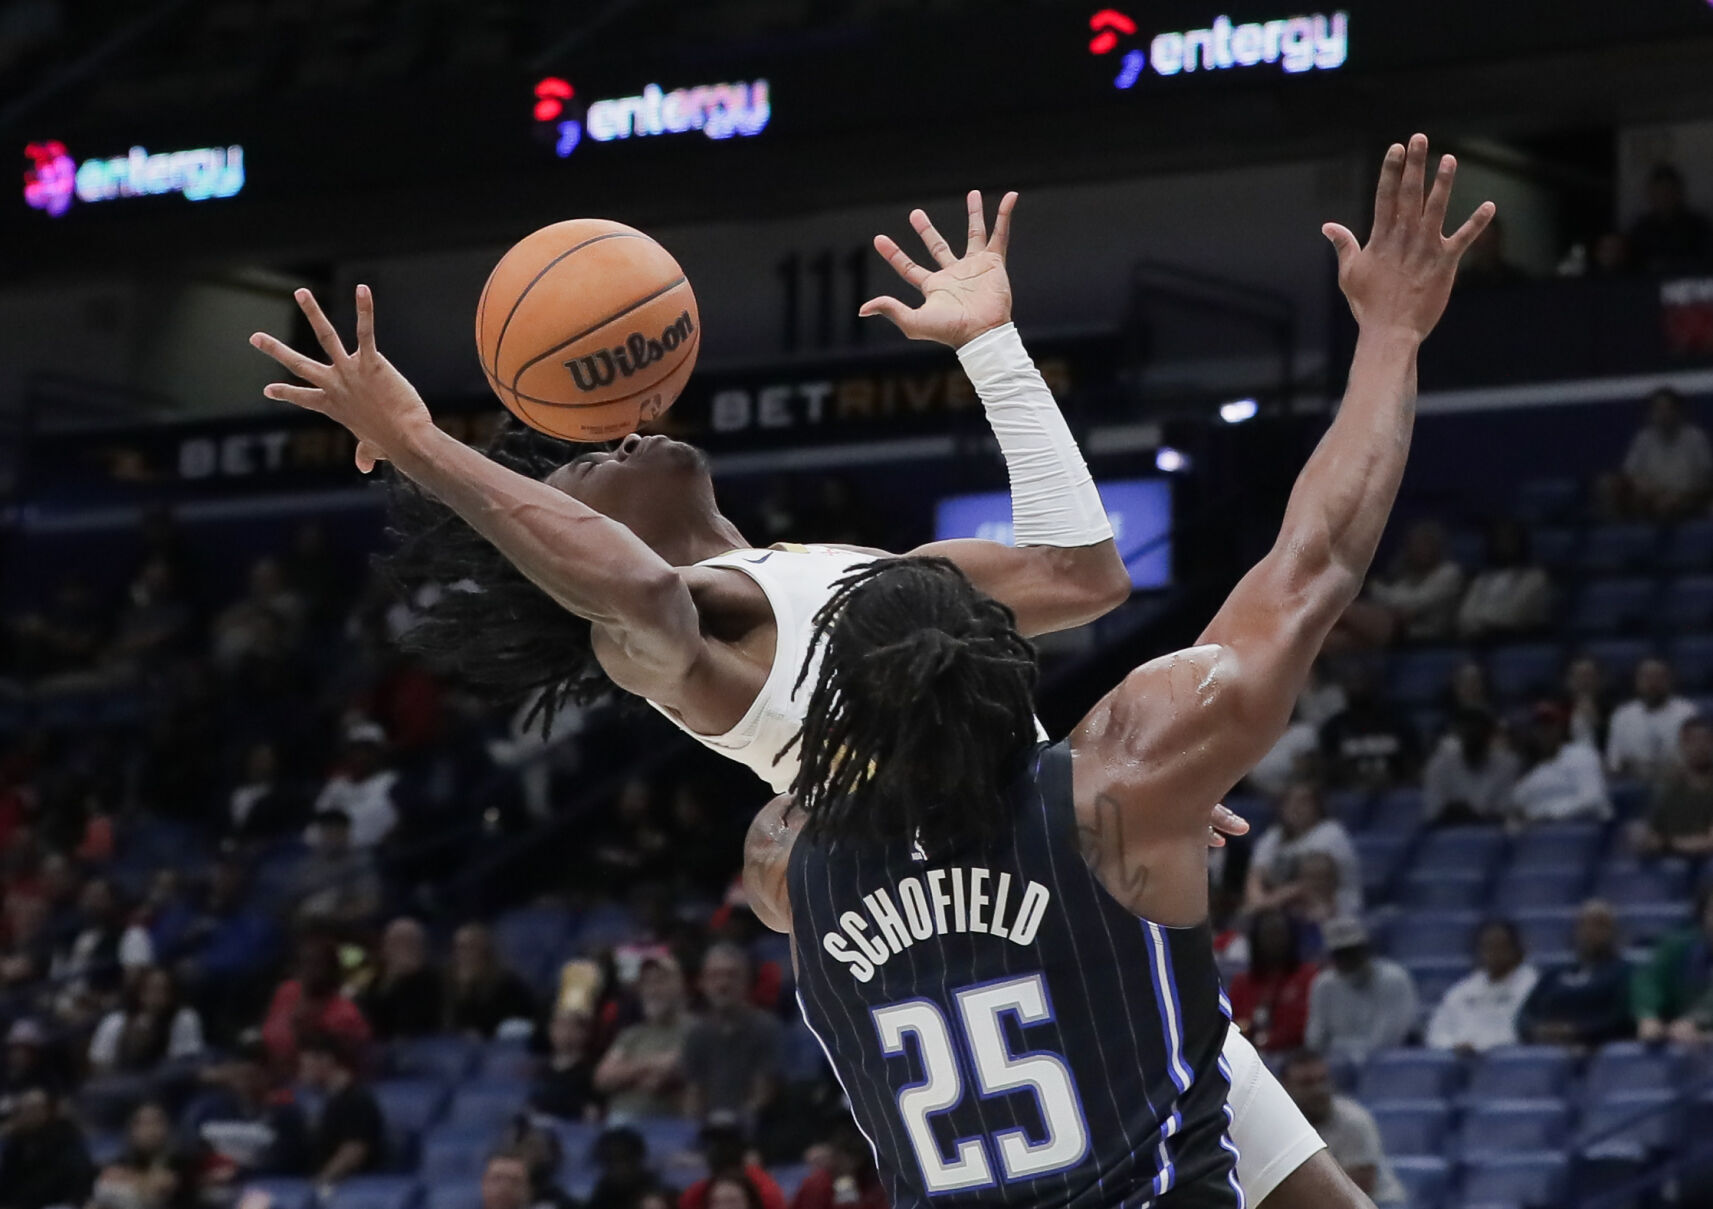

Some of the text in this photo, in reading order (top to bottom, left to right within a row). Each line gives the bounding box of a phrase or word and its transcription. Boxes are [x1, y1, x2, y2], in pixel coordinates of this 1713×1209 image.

[1150, 11, 1348, 76] entergy
[587, 78, 770, 142] entergy
[76, 144, 245, 202] entergy
[564, 310, 695, 393] Wilson
[823, 867, 1050, 984] SCHOFIELD
[868, 972, 1090, 1197] 25
